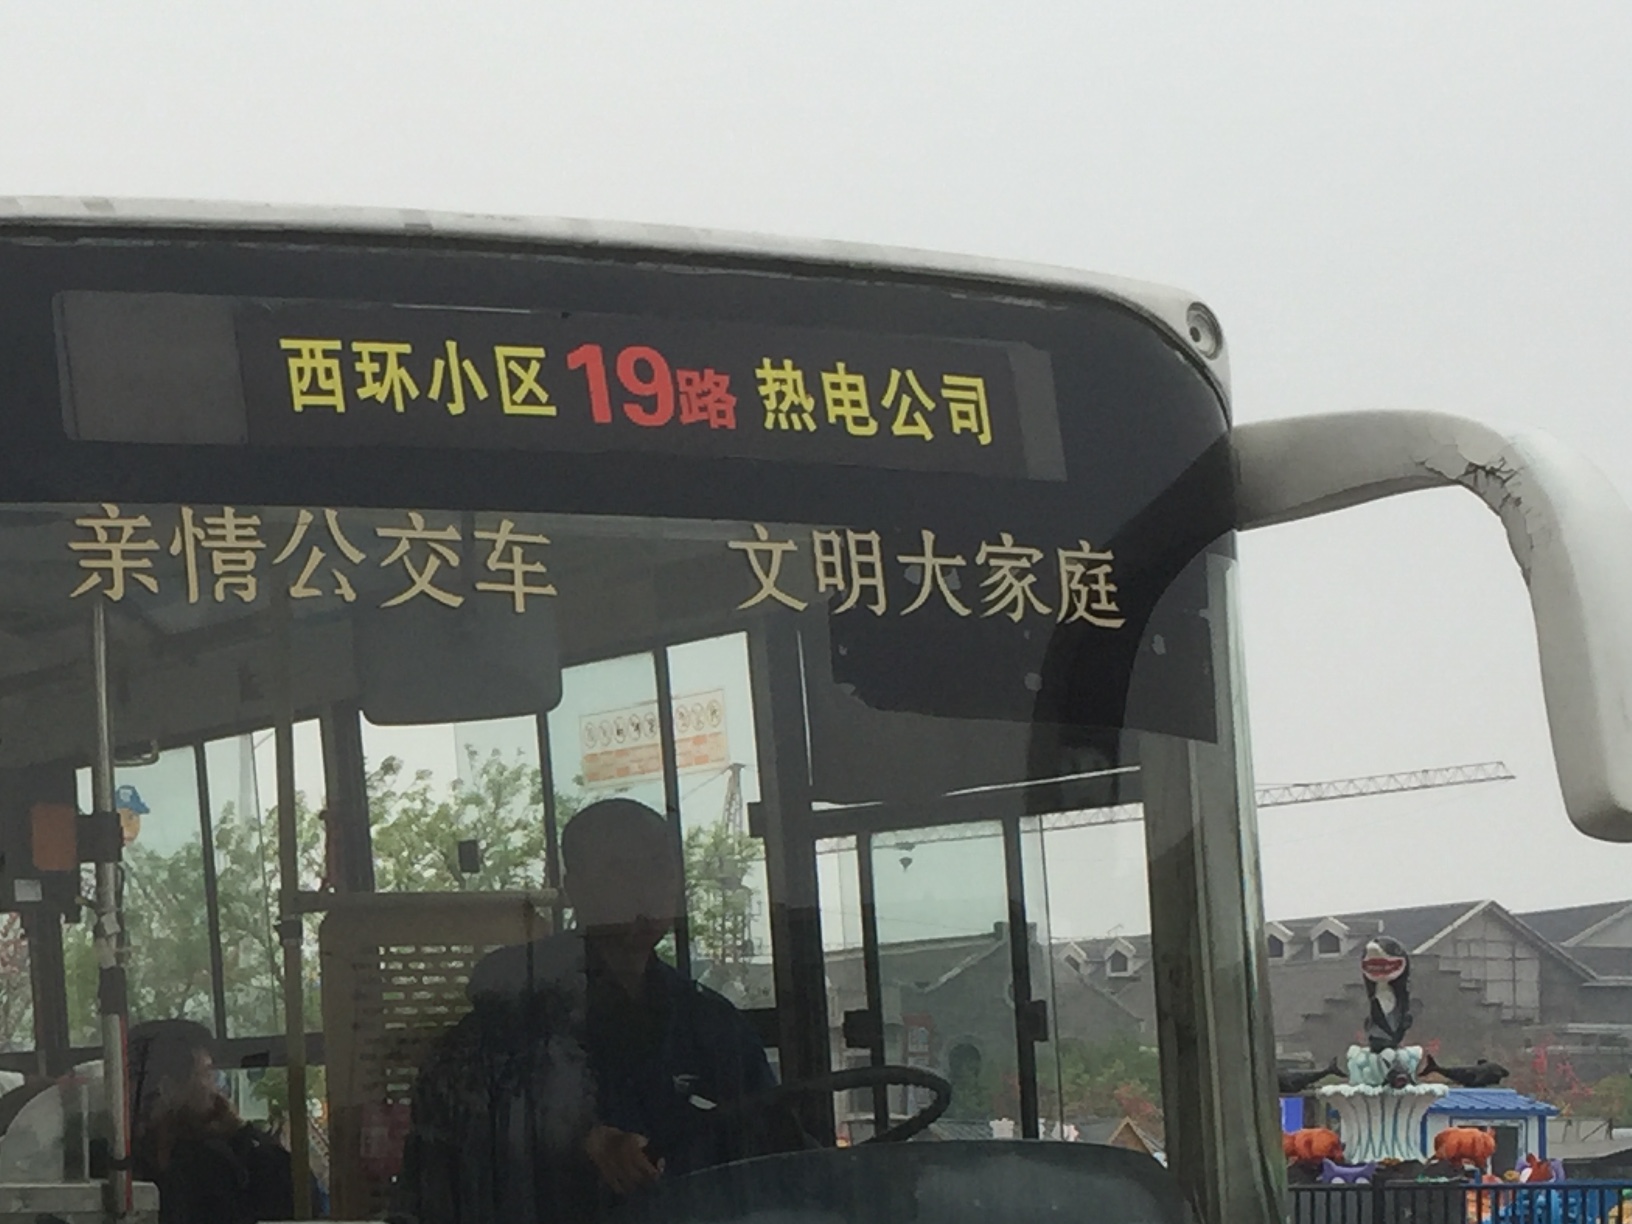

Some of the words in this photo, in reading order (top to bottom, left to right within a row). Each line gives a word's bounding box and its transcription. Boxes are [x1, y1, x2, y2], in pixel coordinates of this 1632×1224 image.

[279, 337, 557, 418] 西环小区
[755, 356, 993, 446] 热电公司
[68, 504, 559, 613] 亲情公交车
[728, 523, 1127, 629] 文明大家庭
